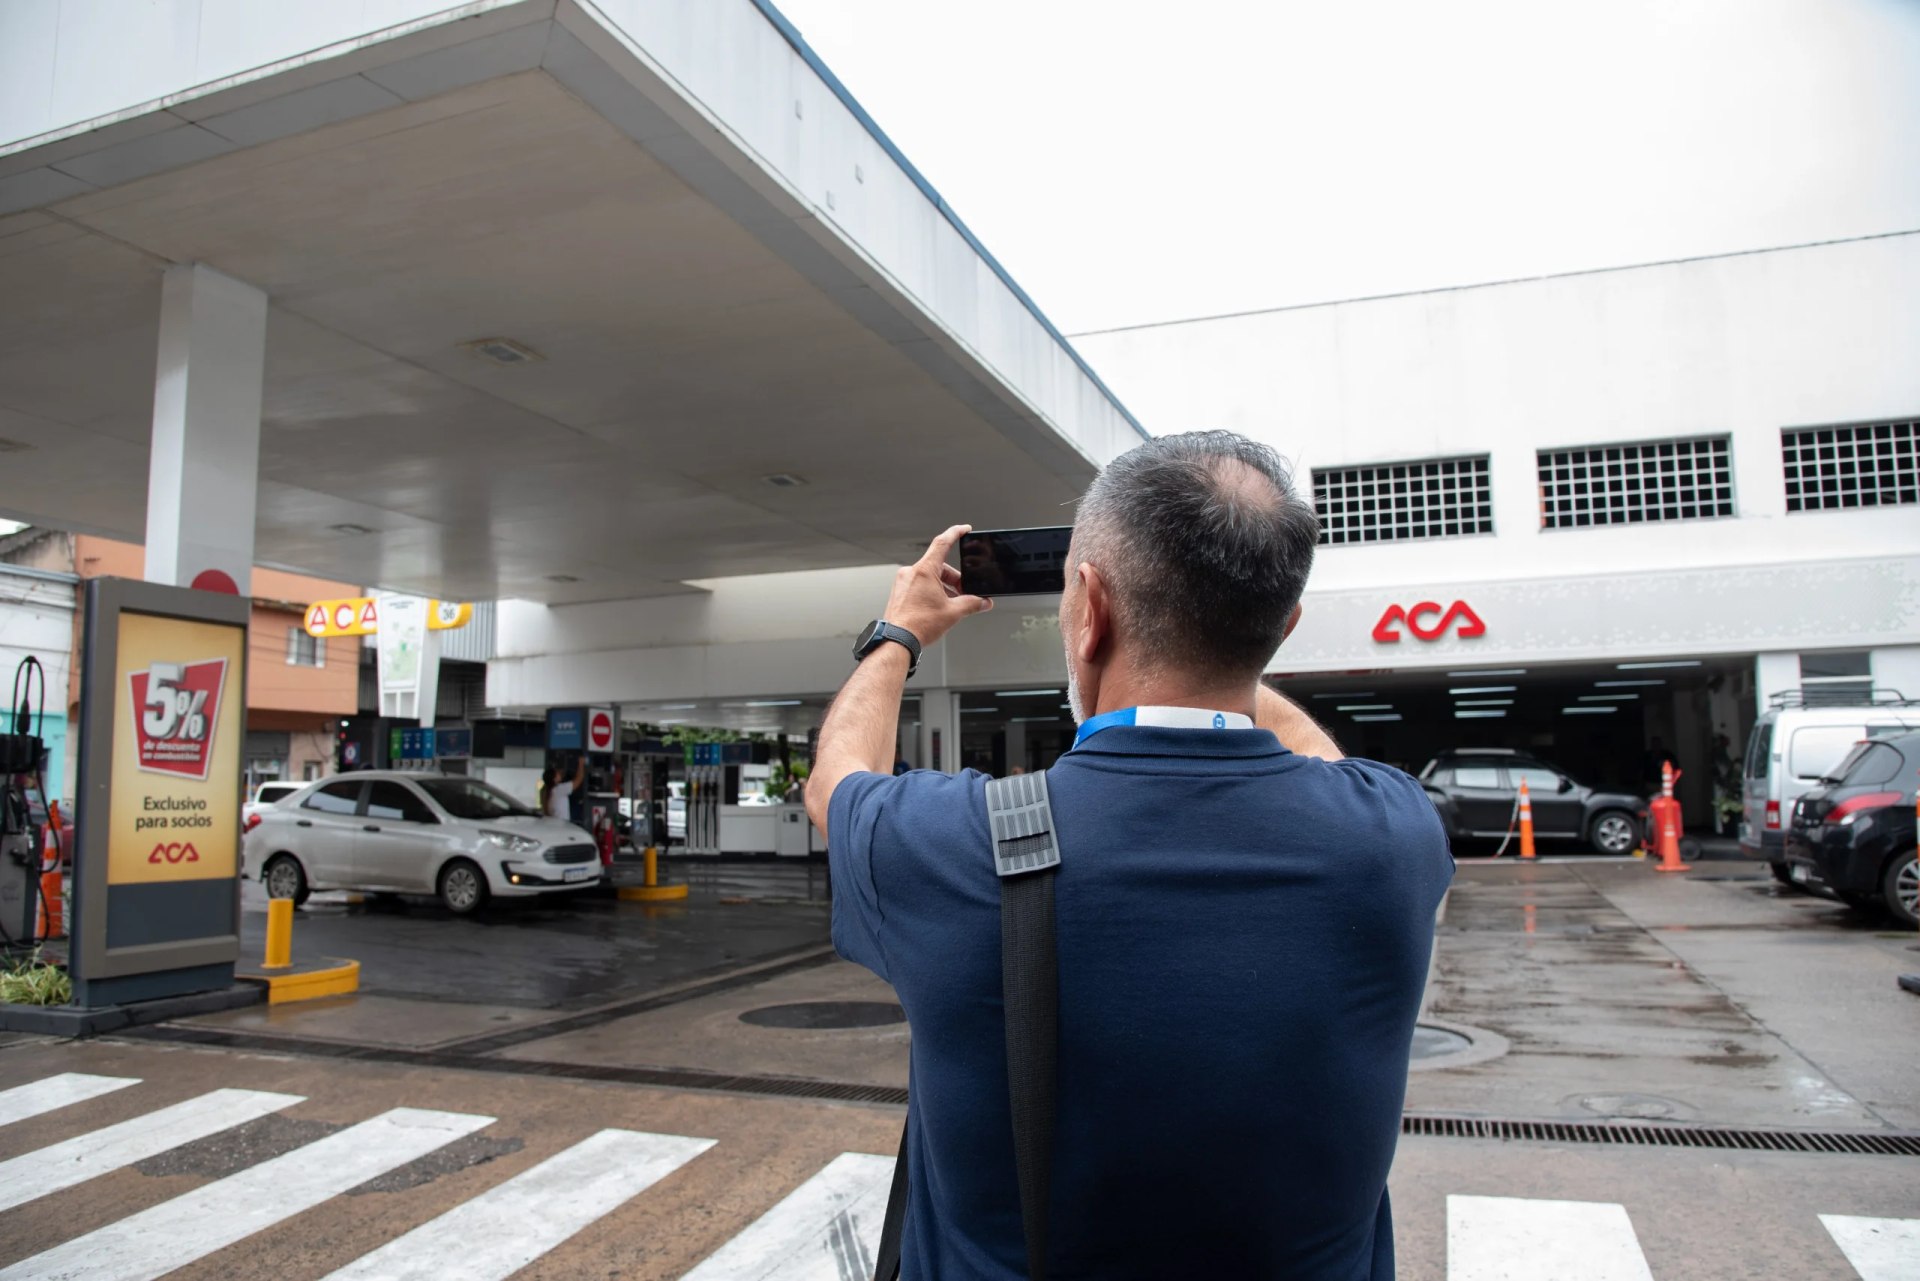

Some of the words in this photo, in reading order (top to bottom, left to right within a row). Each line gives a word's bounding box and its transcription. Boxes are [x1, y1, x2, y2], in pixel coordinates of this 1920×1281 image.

[1372, 600, 1486, 642] ACA
[143, 661, 208, 740] 5%
[143, 741, 155, 751] de
[156, 743, 201, 752] descuento
[143, 796, 207, 811] Exclusivo
[135, 816, 168, 832] para
[171, 813, 212, 828] socios
[147, 842, 200, 865] ACA
